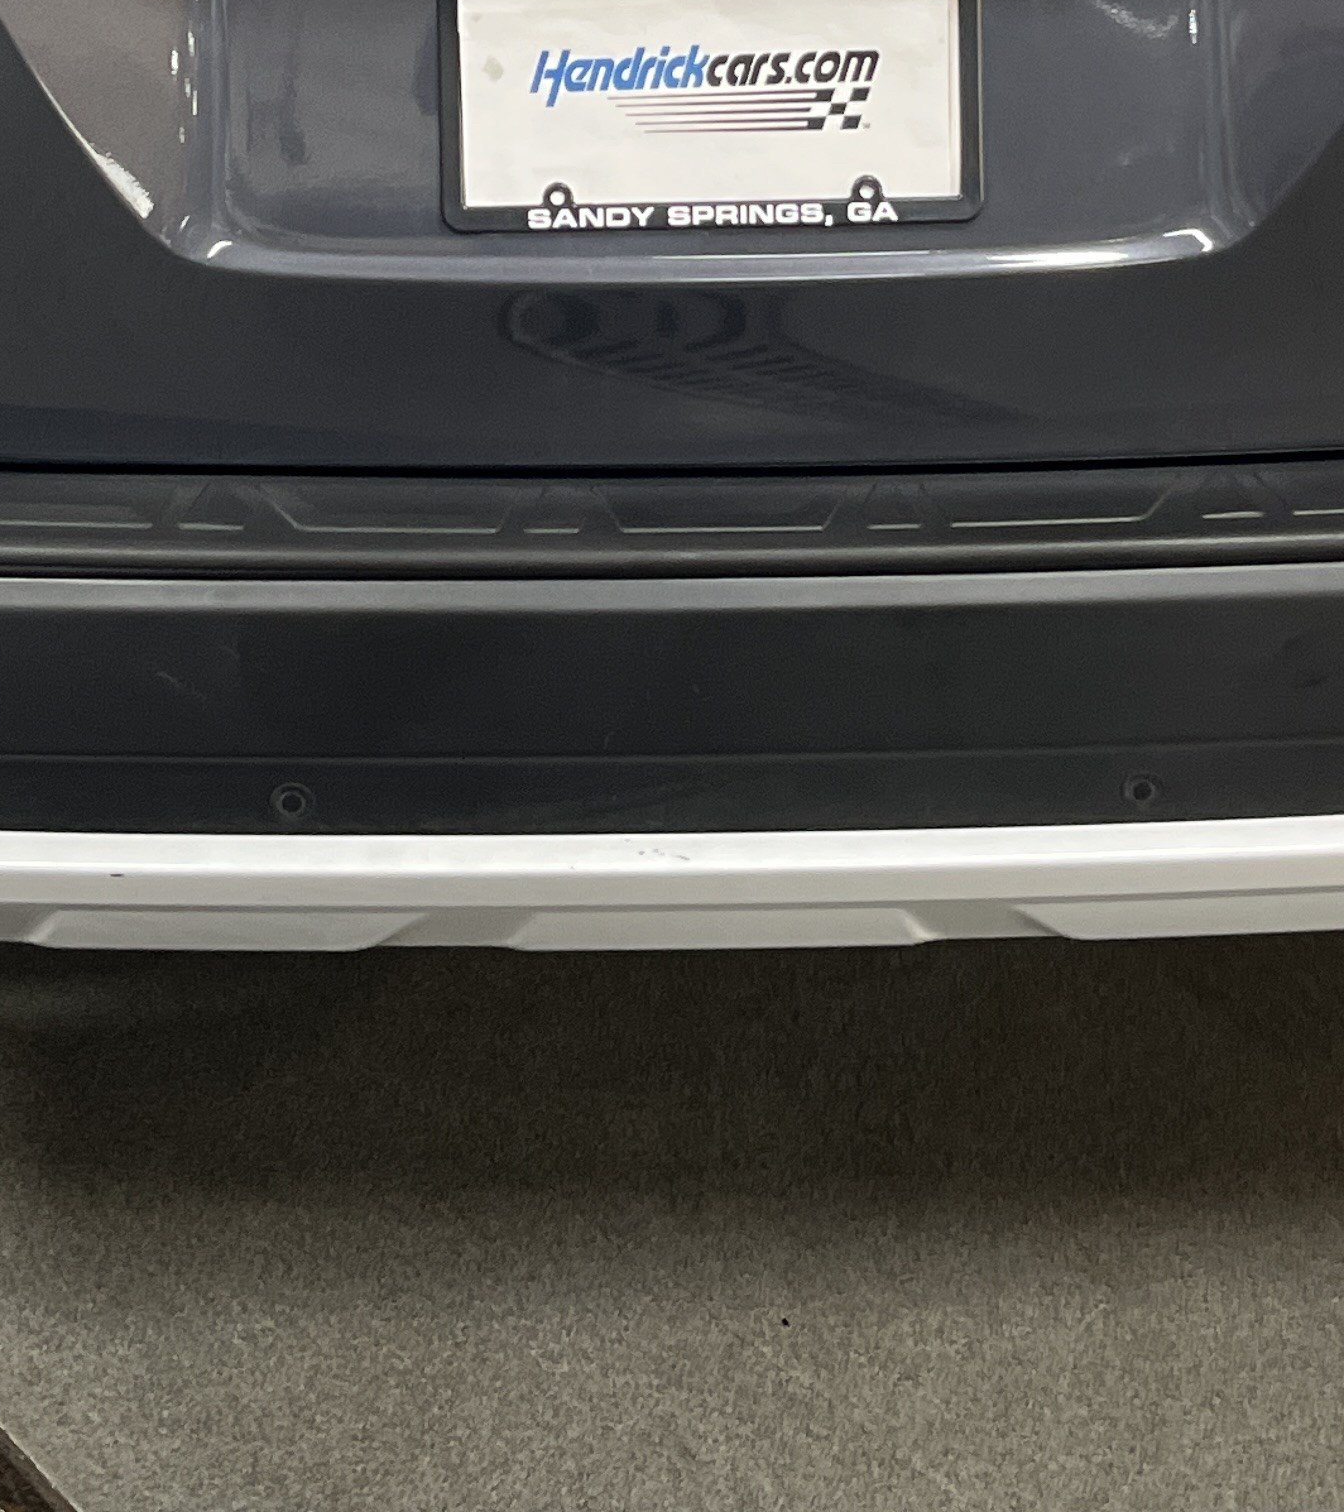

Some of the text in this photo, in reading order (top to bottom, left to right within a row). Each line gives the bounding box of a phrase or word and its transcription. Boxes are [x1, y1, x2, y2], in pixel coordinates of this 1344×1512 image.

[529, 44, 880, 108] Hendrickcars.com
[527, 201, 899, 230] SANDY SPRINGS, GA
